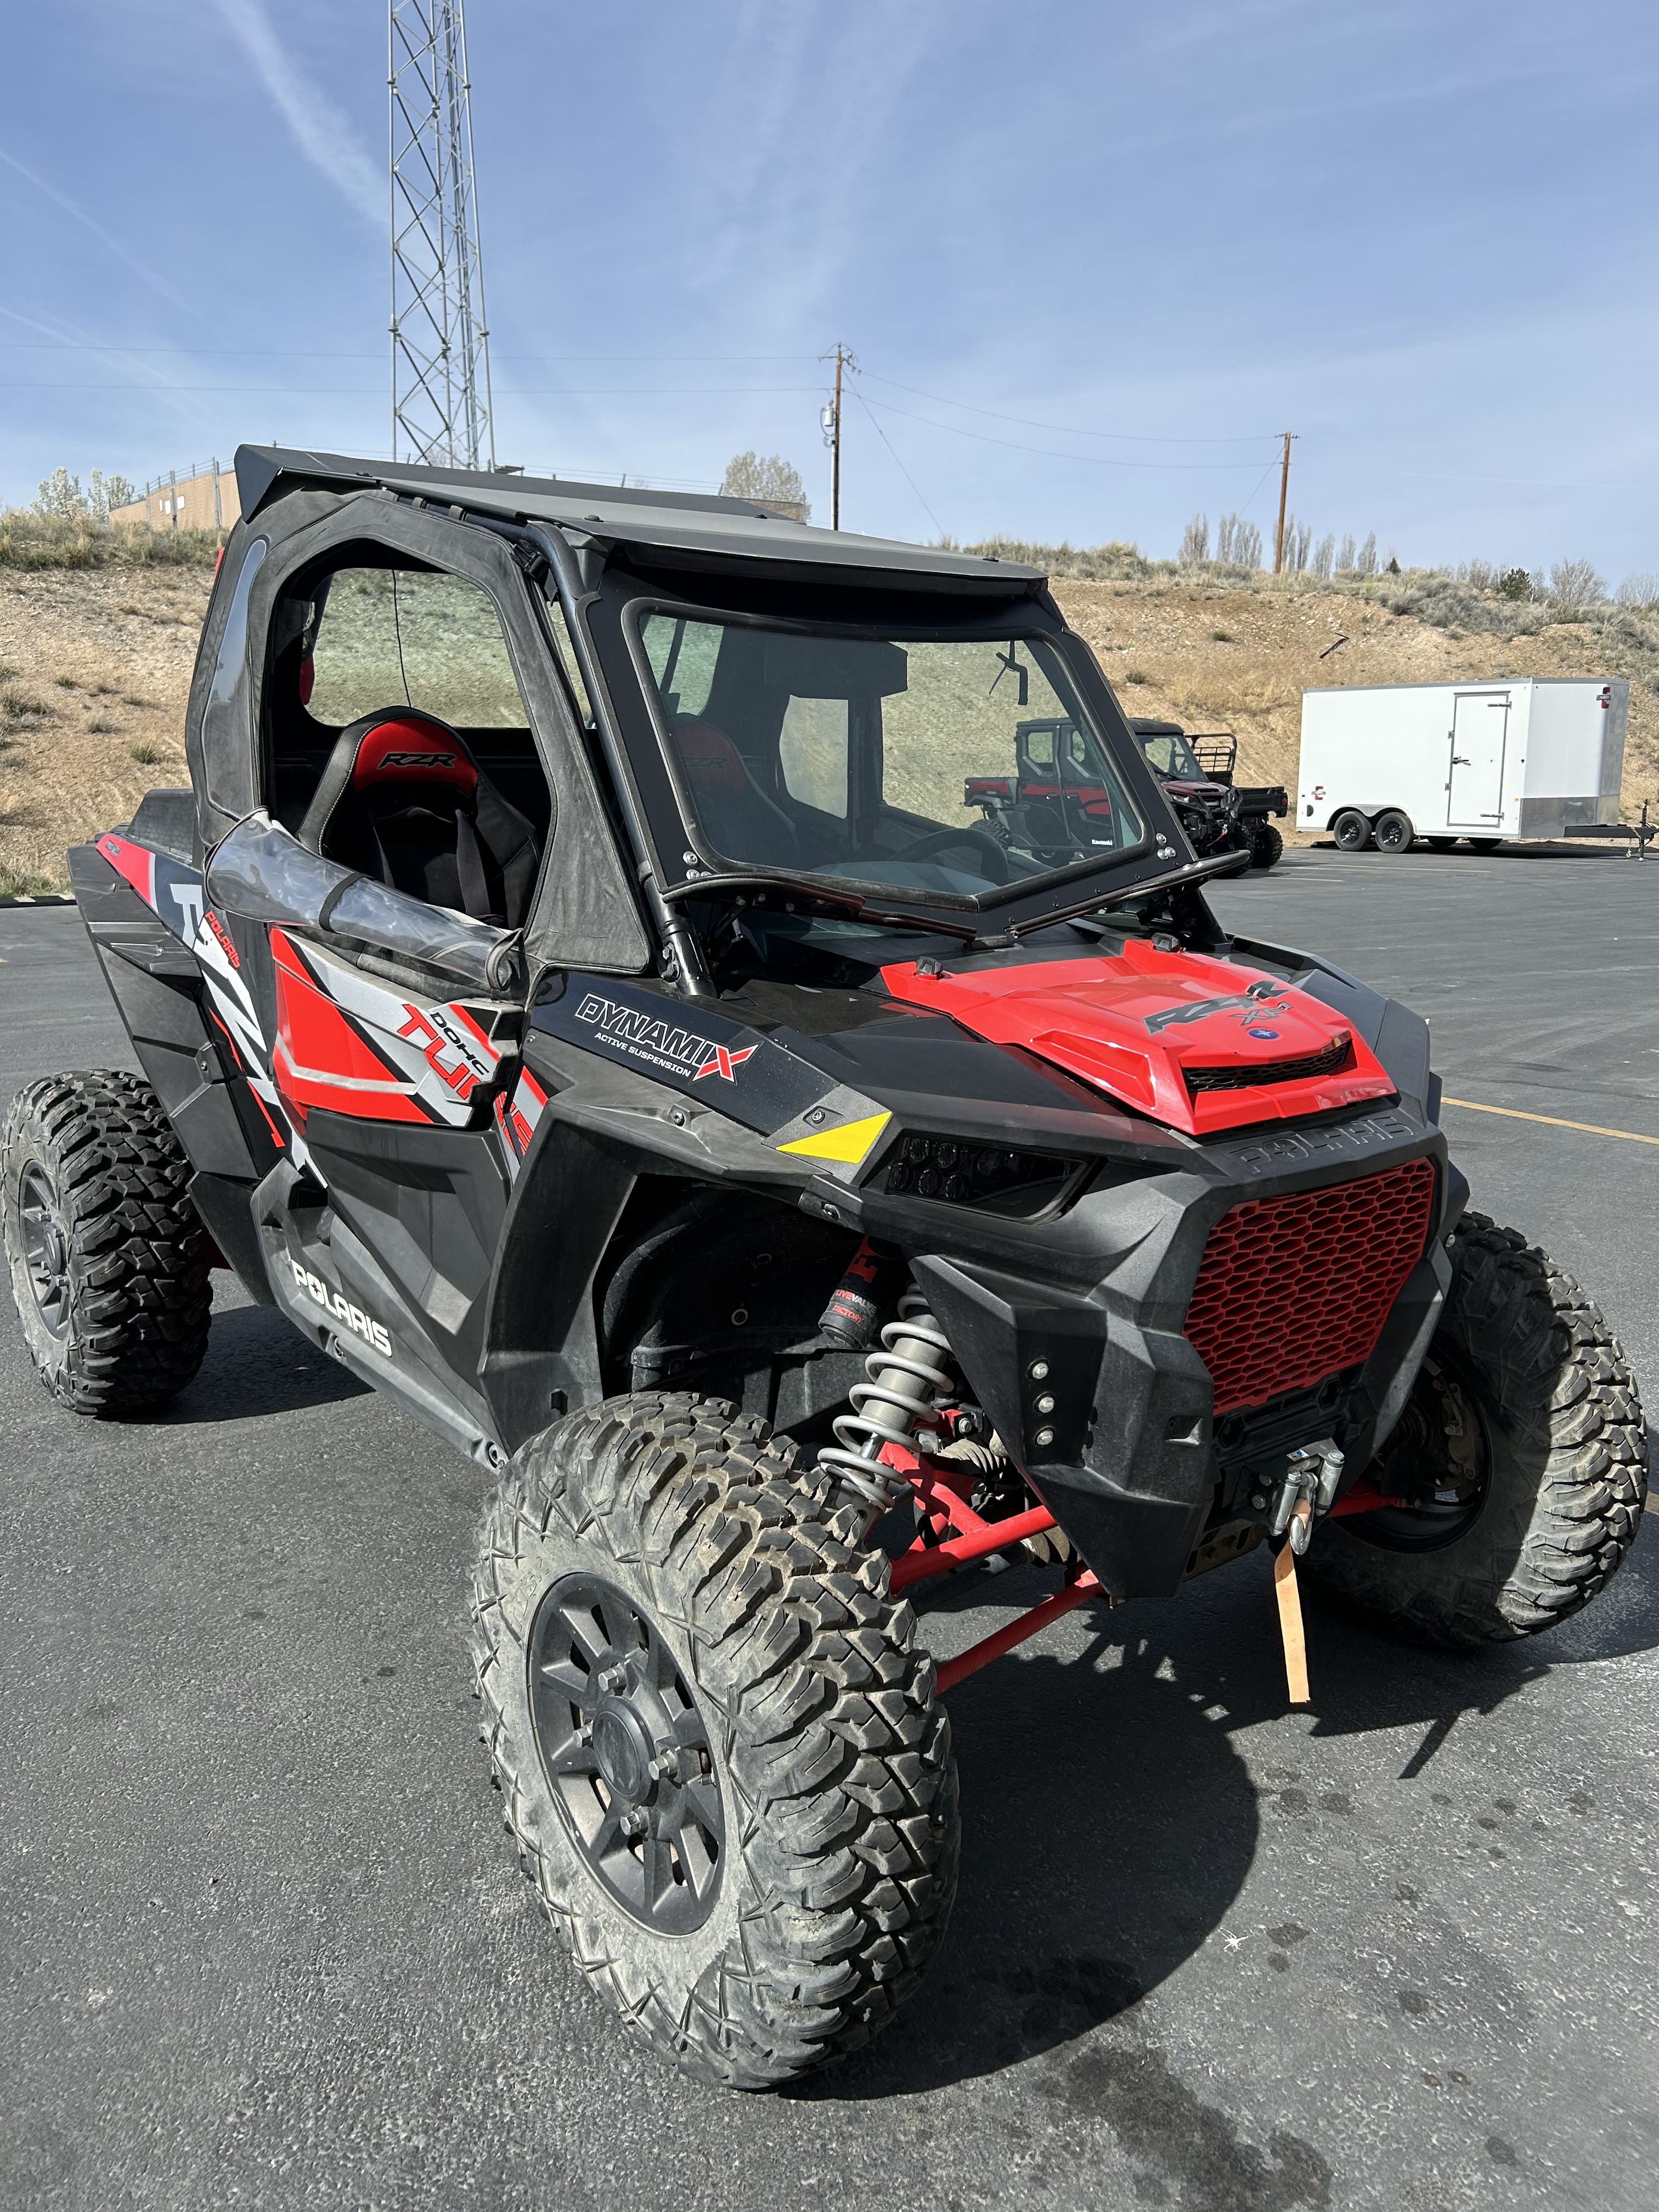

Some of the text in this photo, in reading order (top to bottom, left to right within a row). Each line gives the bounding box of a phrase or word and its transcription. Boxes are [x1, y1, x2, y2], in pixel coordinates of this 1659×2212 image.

[377, 752, 457, 770] RZR
[681, 755, 729, 770] ZR
[205, 910, 240, 969] POLARIS
[430, 1012, 490, 1075] DOHC
[574, 993, 759, 1082] DYNAMIX
[594, 1032, 691, 1077] ACTIVE SUSPENSION
[1229, 1115, 1415, 1174] POLARIS
[291, 1259, 392, 1357] POLARIS
